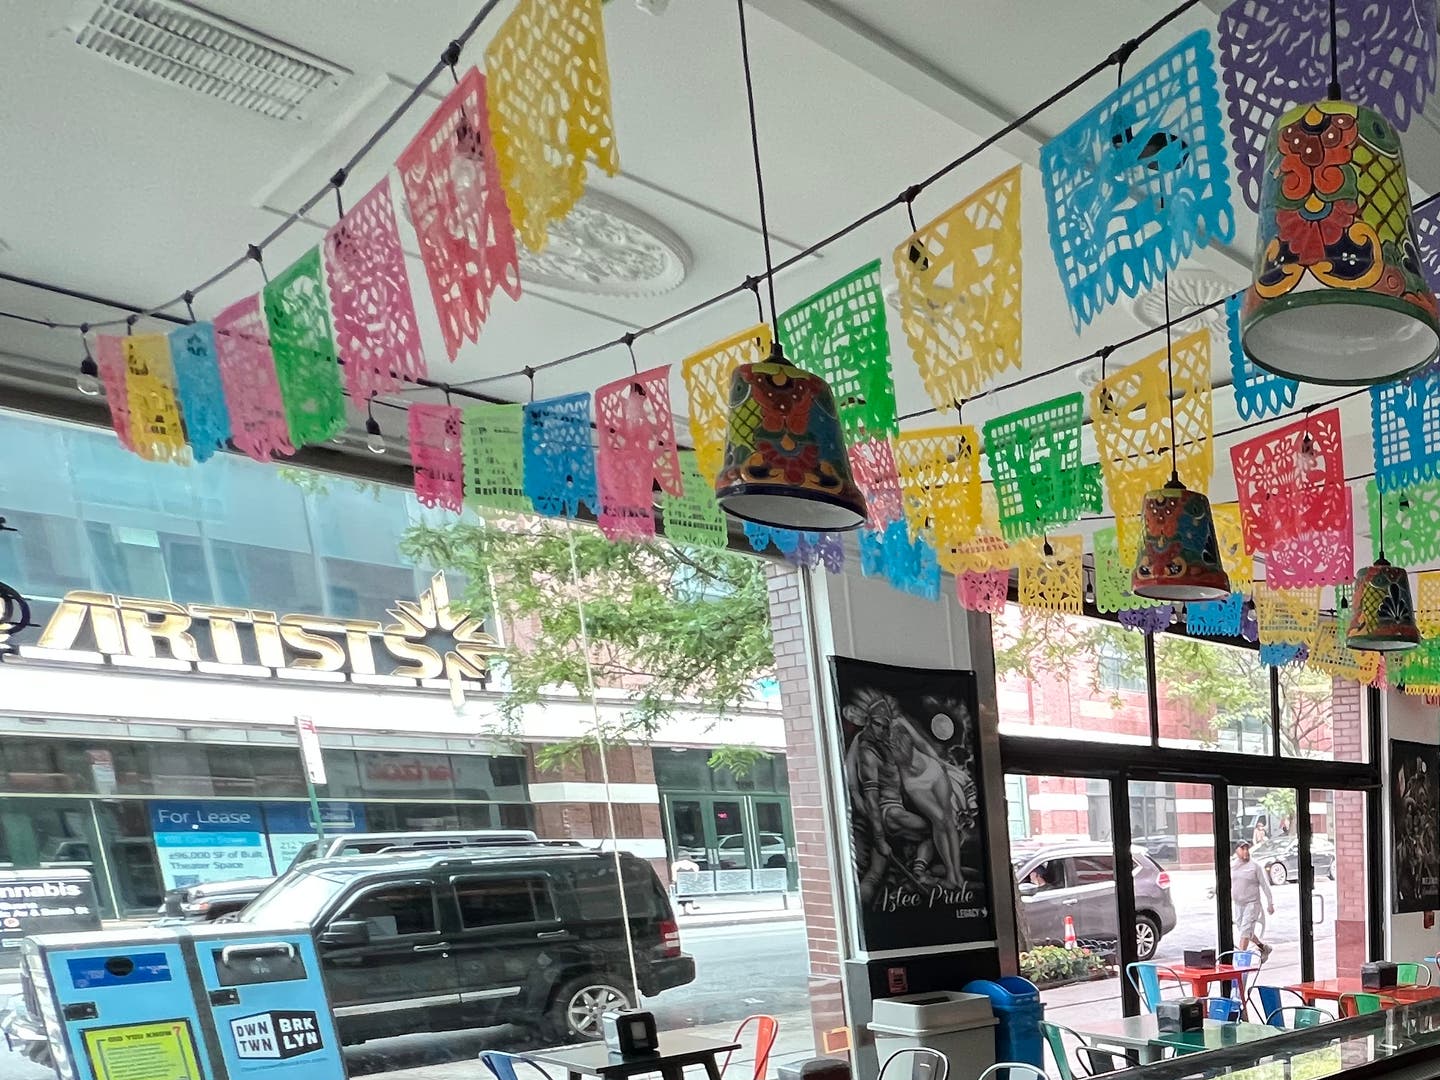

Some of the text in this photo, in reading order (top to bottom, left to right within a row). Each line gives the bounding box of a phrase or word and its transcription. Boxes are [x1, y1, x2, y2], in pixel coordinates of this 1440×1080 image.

[37, 590, 445, 680] ARTISTS
[158, 809, 251, 825] For Lease
[214, 862, 244, 870] Space
[928, 880, 974, 909] Pride
[236, 1021, 269, 1037] DWN
[278, 1018, 314, 1033] BRK
[239, 1038, 273, 1052] TWN
[282, 1032, 319, 1050] LYN
